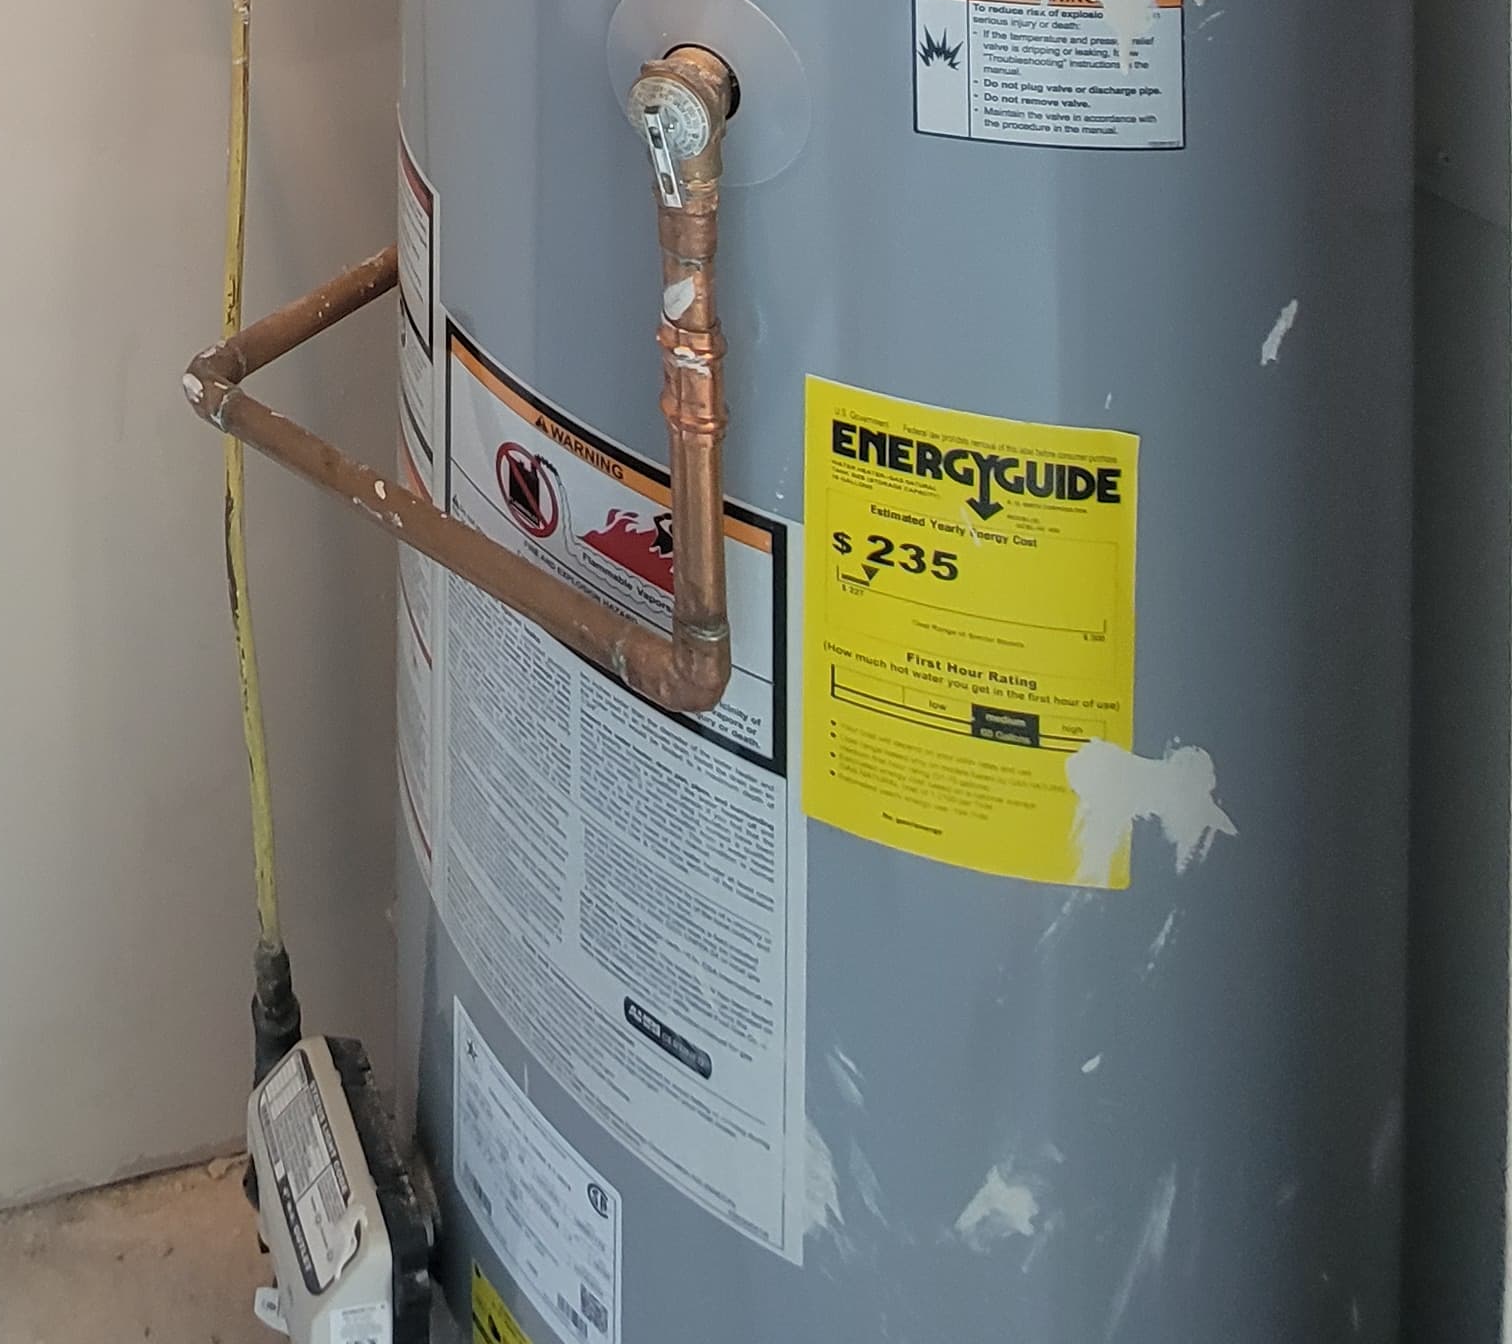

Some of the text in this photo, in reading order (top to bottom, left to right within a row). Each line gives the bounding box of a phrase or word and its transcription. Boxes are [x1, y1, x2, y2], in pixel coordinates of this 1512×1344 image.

[974, 4, 985, 12] To
[988, 5, 1024, 15] reduce
[1048, 9, 1059, 17] of
[1061, 10, 1103, 20] explosio
[973, 16, 1008, 26] serious
[1011, 19, 1037, 29] injury
[1052, 21, 1081, 30] death:
[983, 30, 990, 38] If
[992, 31, 1007, 39] the
[1010, 32, 1067, 45] temperature
[1070, 35, 1087, 45] and
[984, 42, 1008, 52] valve
[1012, 45, 1020, 53] is
[1022, 45, 1060, 56] dripping
[1075, 47, 1110, 58] leaking,
[984, 66, 1022, 76] manual.
[1069, 60, 1120, 69] instructions
[984, 79, 998, 87] Do
[1001, 81, 1017, 89] not
[1021, 83, 1043, 93] plug
[1046, 85, 1073, 93] valve
[1088, 86, 1136, 96] discharge
[1139, 87, 1162, 96] pipe.
[984, 93, 1091, 108] Do not remove valve.
[984, 107, 1157, 123] Maintain the valve in accordance with
[984, 119, 1000, 127] the
[1002, 122, 1050, 132] procedure
[1053, 124, 1062, 132] in
[1065, 125, 1079, 133] the
[551, 424, 624, 480] WARNING
[832, 419, 1121, 512] ENERGYGUIDE
[870, 504, 926, 528] Estimated
[930, 519, 966, 536] Yearly
[1013, 535, 1037, 548] Cost
[832, 531, 959, 581] $ 235
[582, 552, 632, 591] Flammable
[823, 640, 1121, 712] (How much hot water you get in the first hour of use)
[906, 652, 1038, 691] First Hour Rating
[751, 717, 761, 726] of
[929, 699, 1083, 735] low medium high
[746, 727, 757, 735] or
[995, 729, 1032, 744] Gallons
[731, 730, 760, 749] death.
